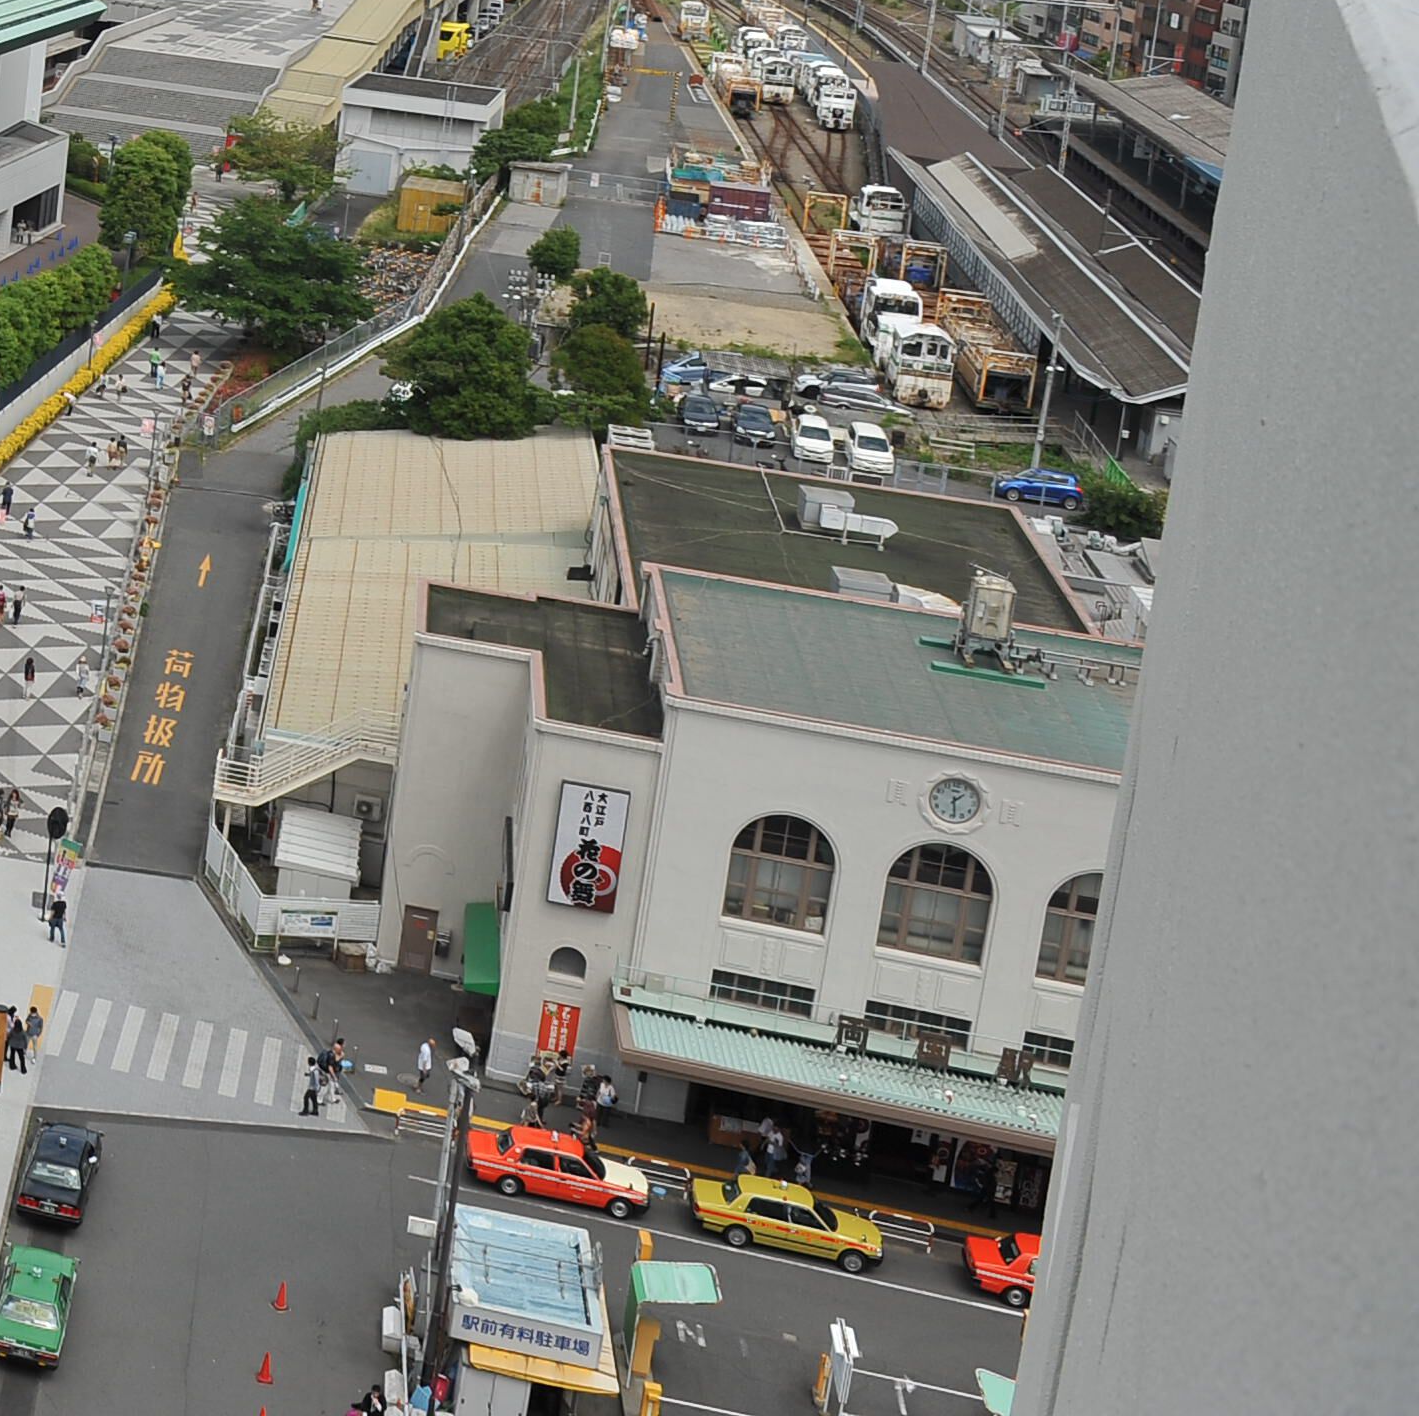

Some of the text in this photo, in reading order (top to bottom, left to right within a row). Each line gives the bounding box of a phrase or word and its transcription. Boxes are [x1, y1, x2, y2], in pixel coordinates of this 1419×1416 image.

[130, 648, 196, 785] 荷物扱所
[578, 790, 595, 838] 八百八町
[594, 792, 609, 827] 大江戸
[571, 838, 601, 905] 花の舞
[461, 1314, 591, 1357] 駅前有料駐車場
